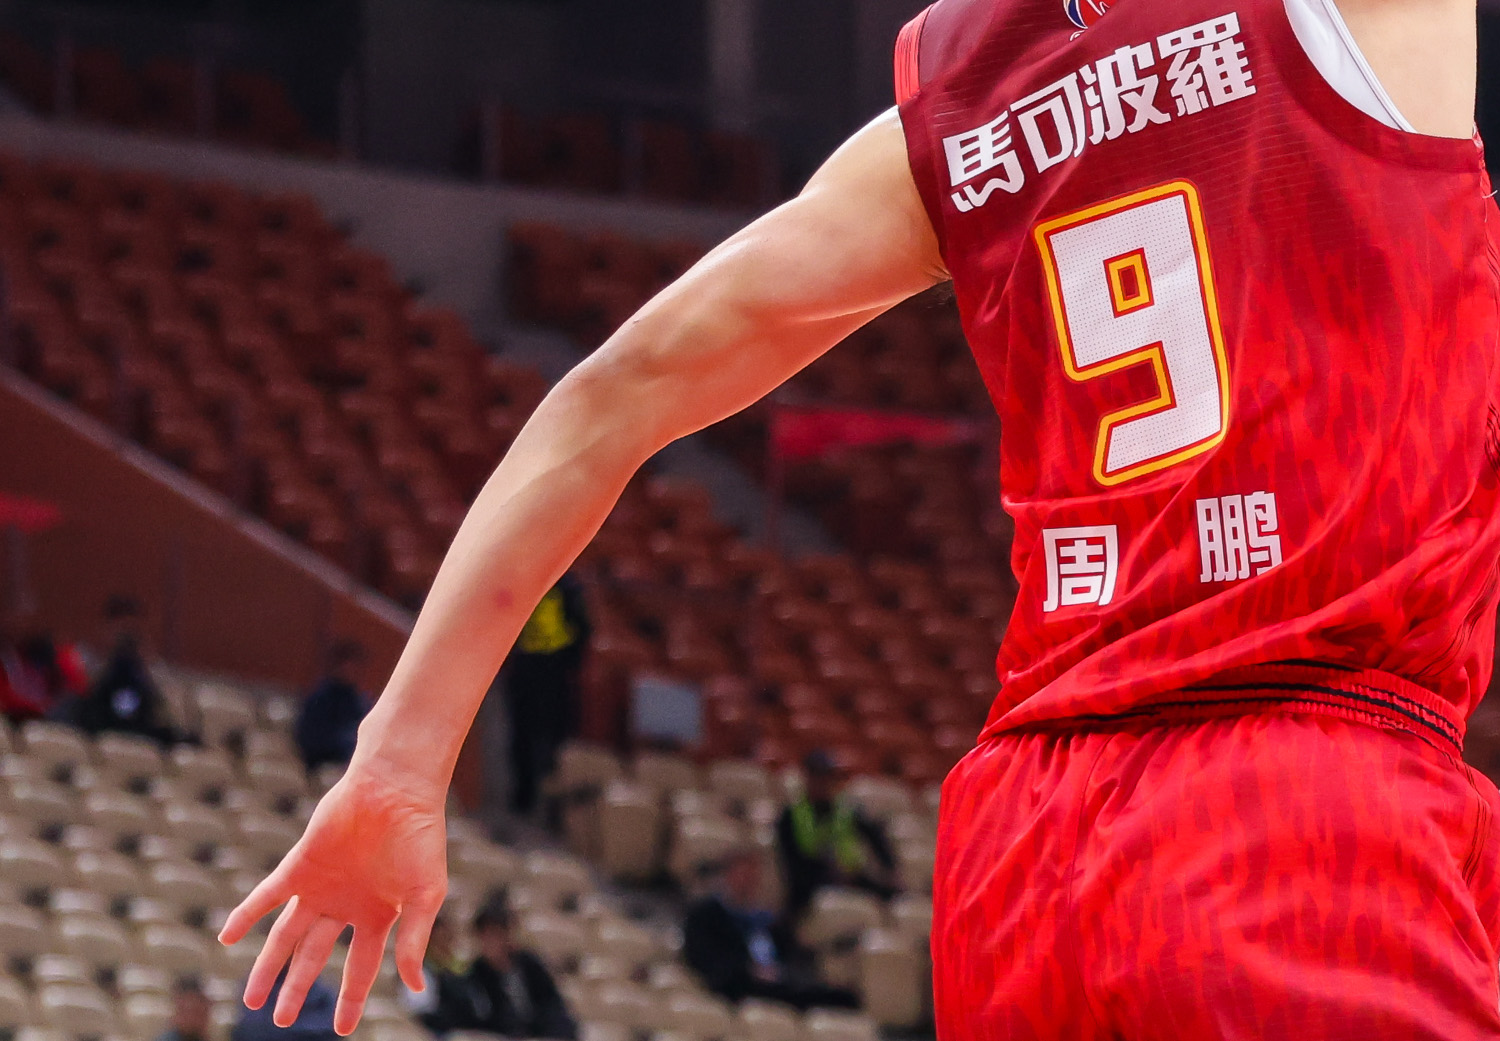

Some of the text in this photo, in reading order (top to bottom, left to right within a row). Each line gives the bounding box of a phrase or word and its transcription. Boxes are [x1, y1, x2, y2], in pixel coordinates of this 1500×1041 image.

[942, 11, 1257, 213] 馬可波羅
[1034, 179, 1231, 488] 9
